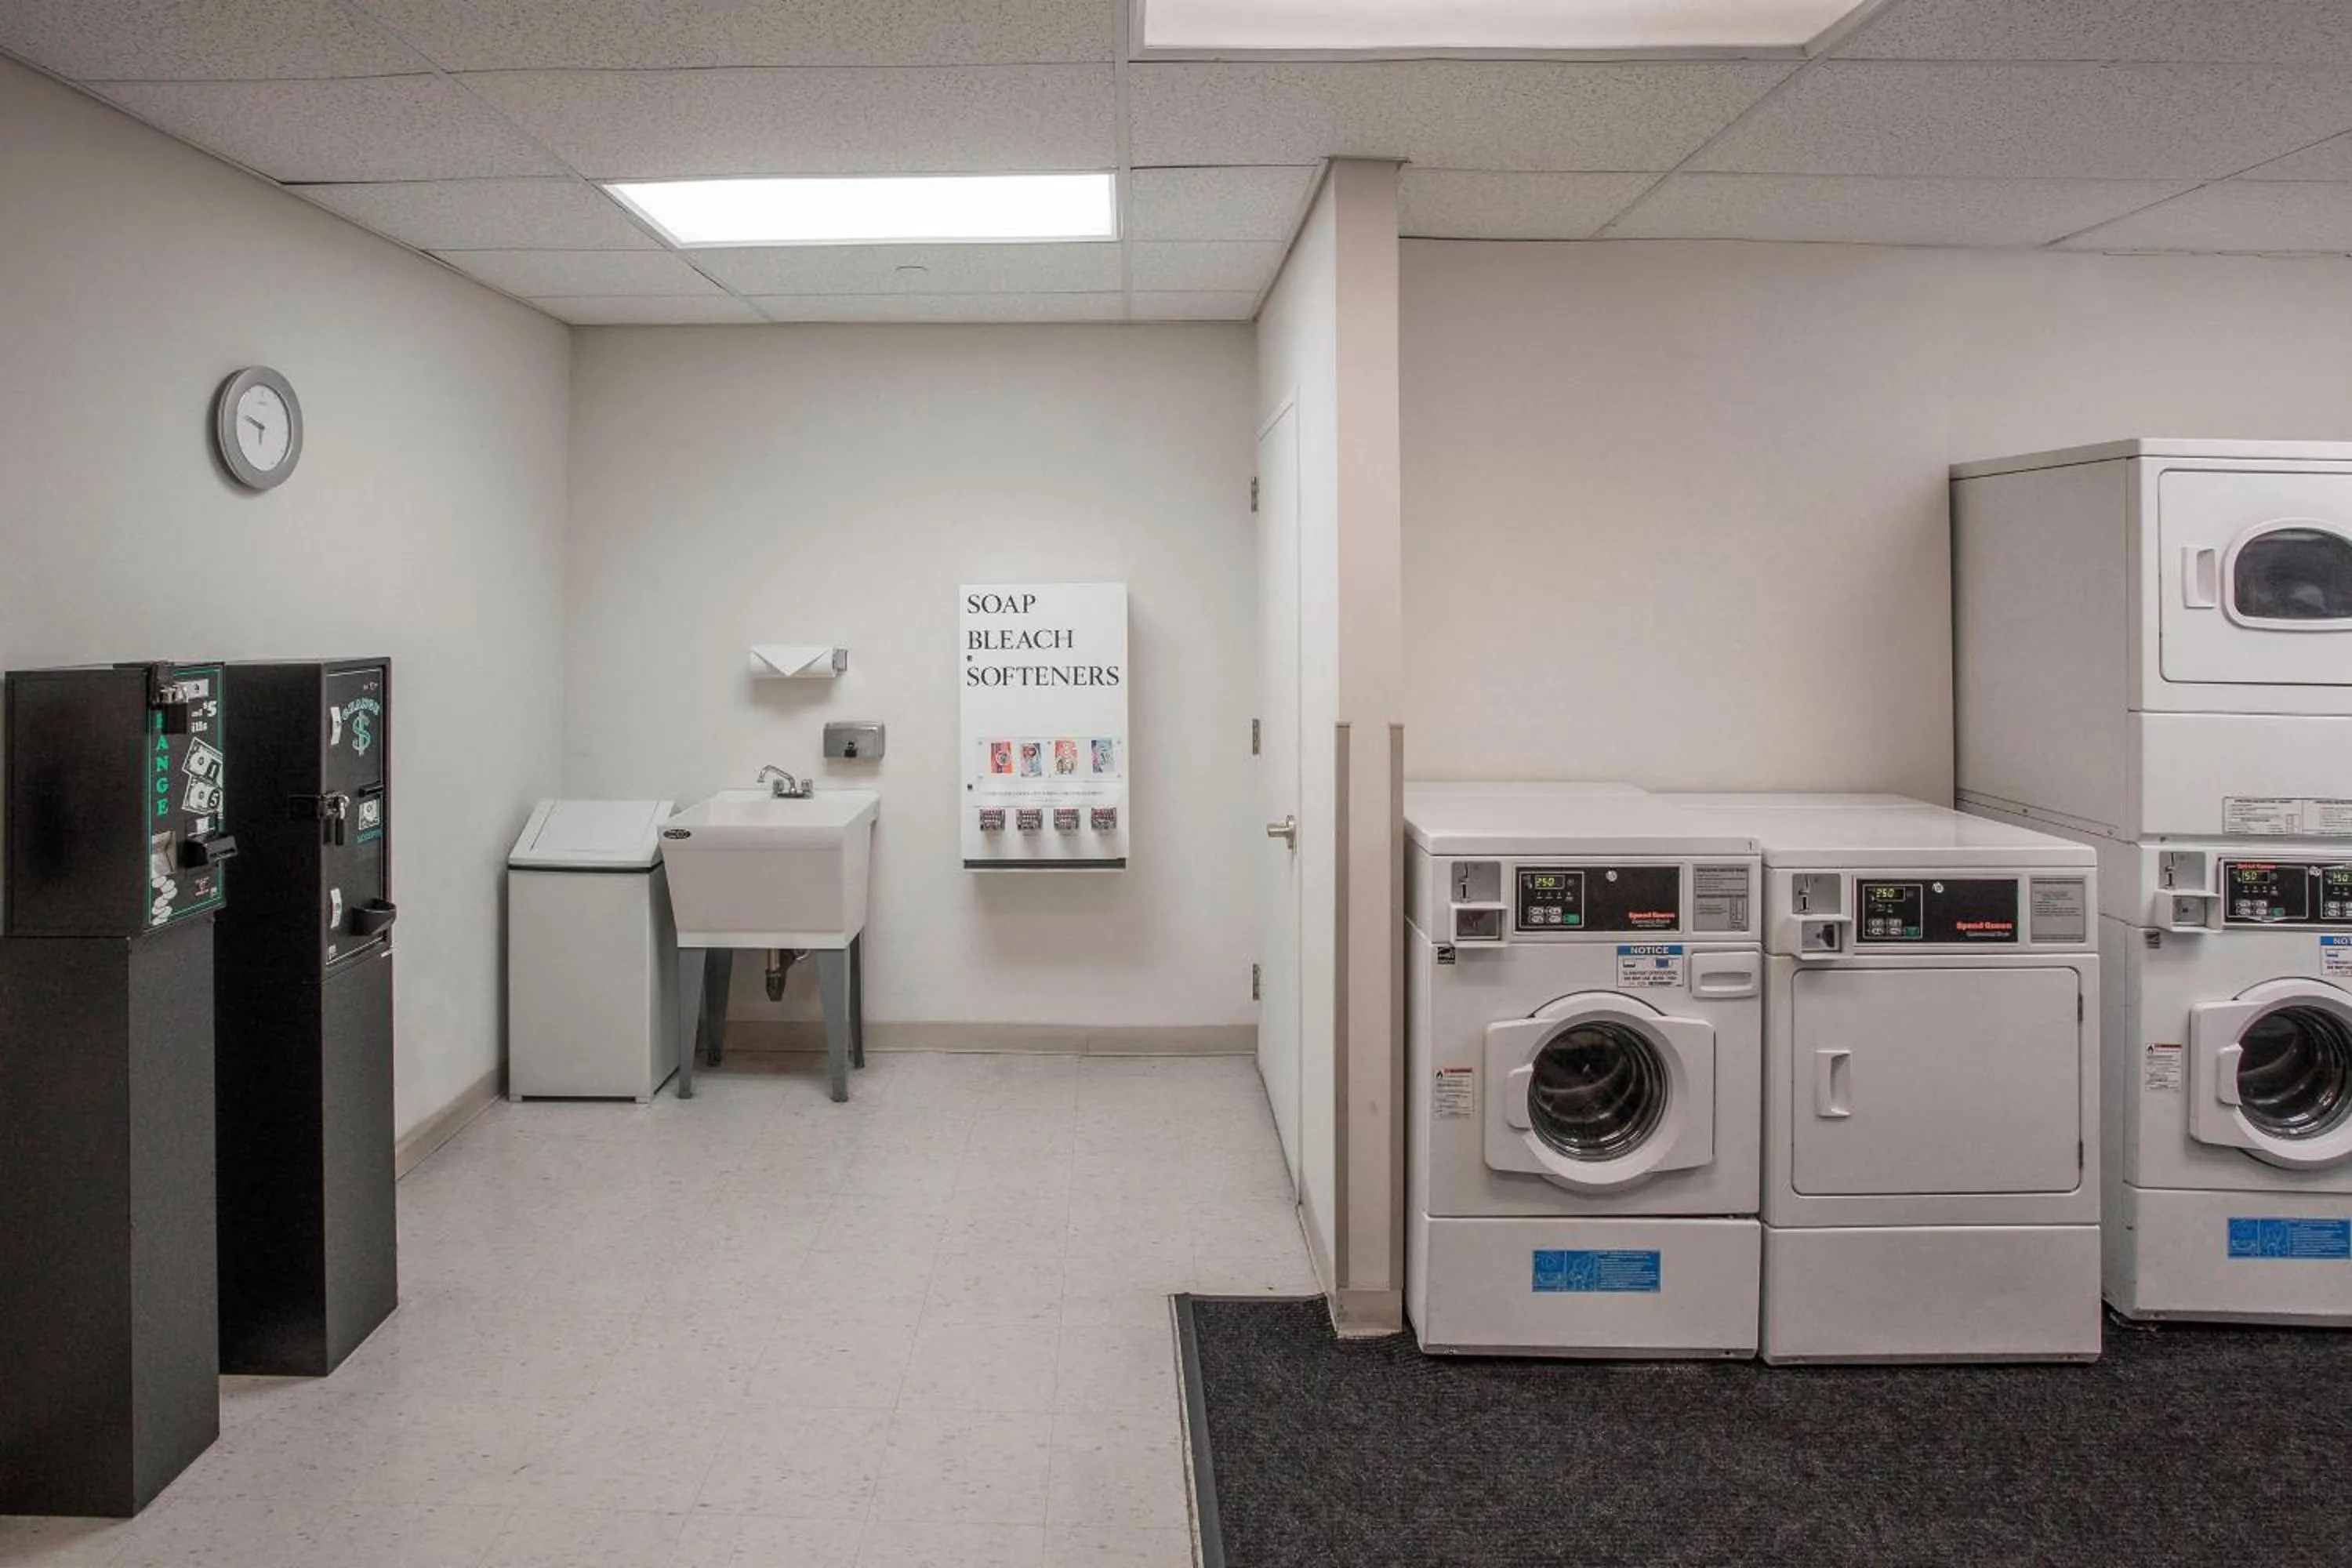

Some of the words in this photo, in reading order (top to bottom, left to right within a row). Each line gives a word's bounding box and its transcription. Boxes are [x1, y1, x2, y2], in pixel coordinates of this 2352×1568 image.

[967, 593, 1036, 614] SOAP
[967, 629, 1073, 650] BLEACH
[967, 666, 1120, 686] SOFTENERS
[156, 710, 169, 815] ANGE
